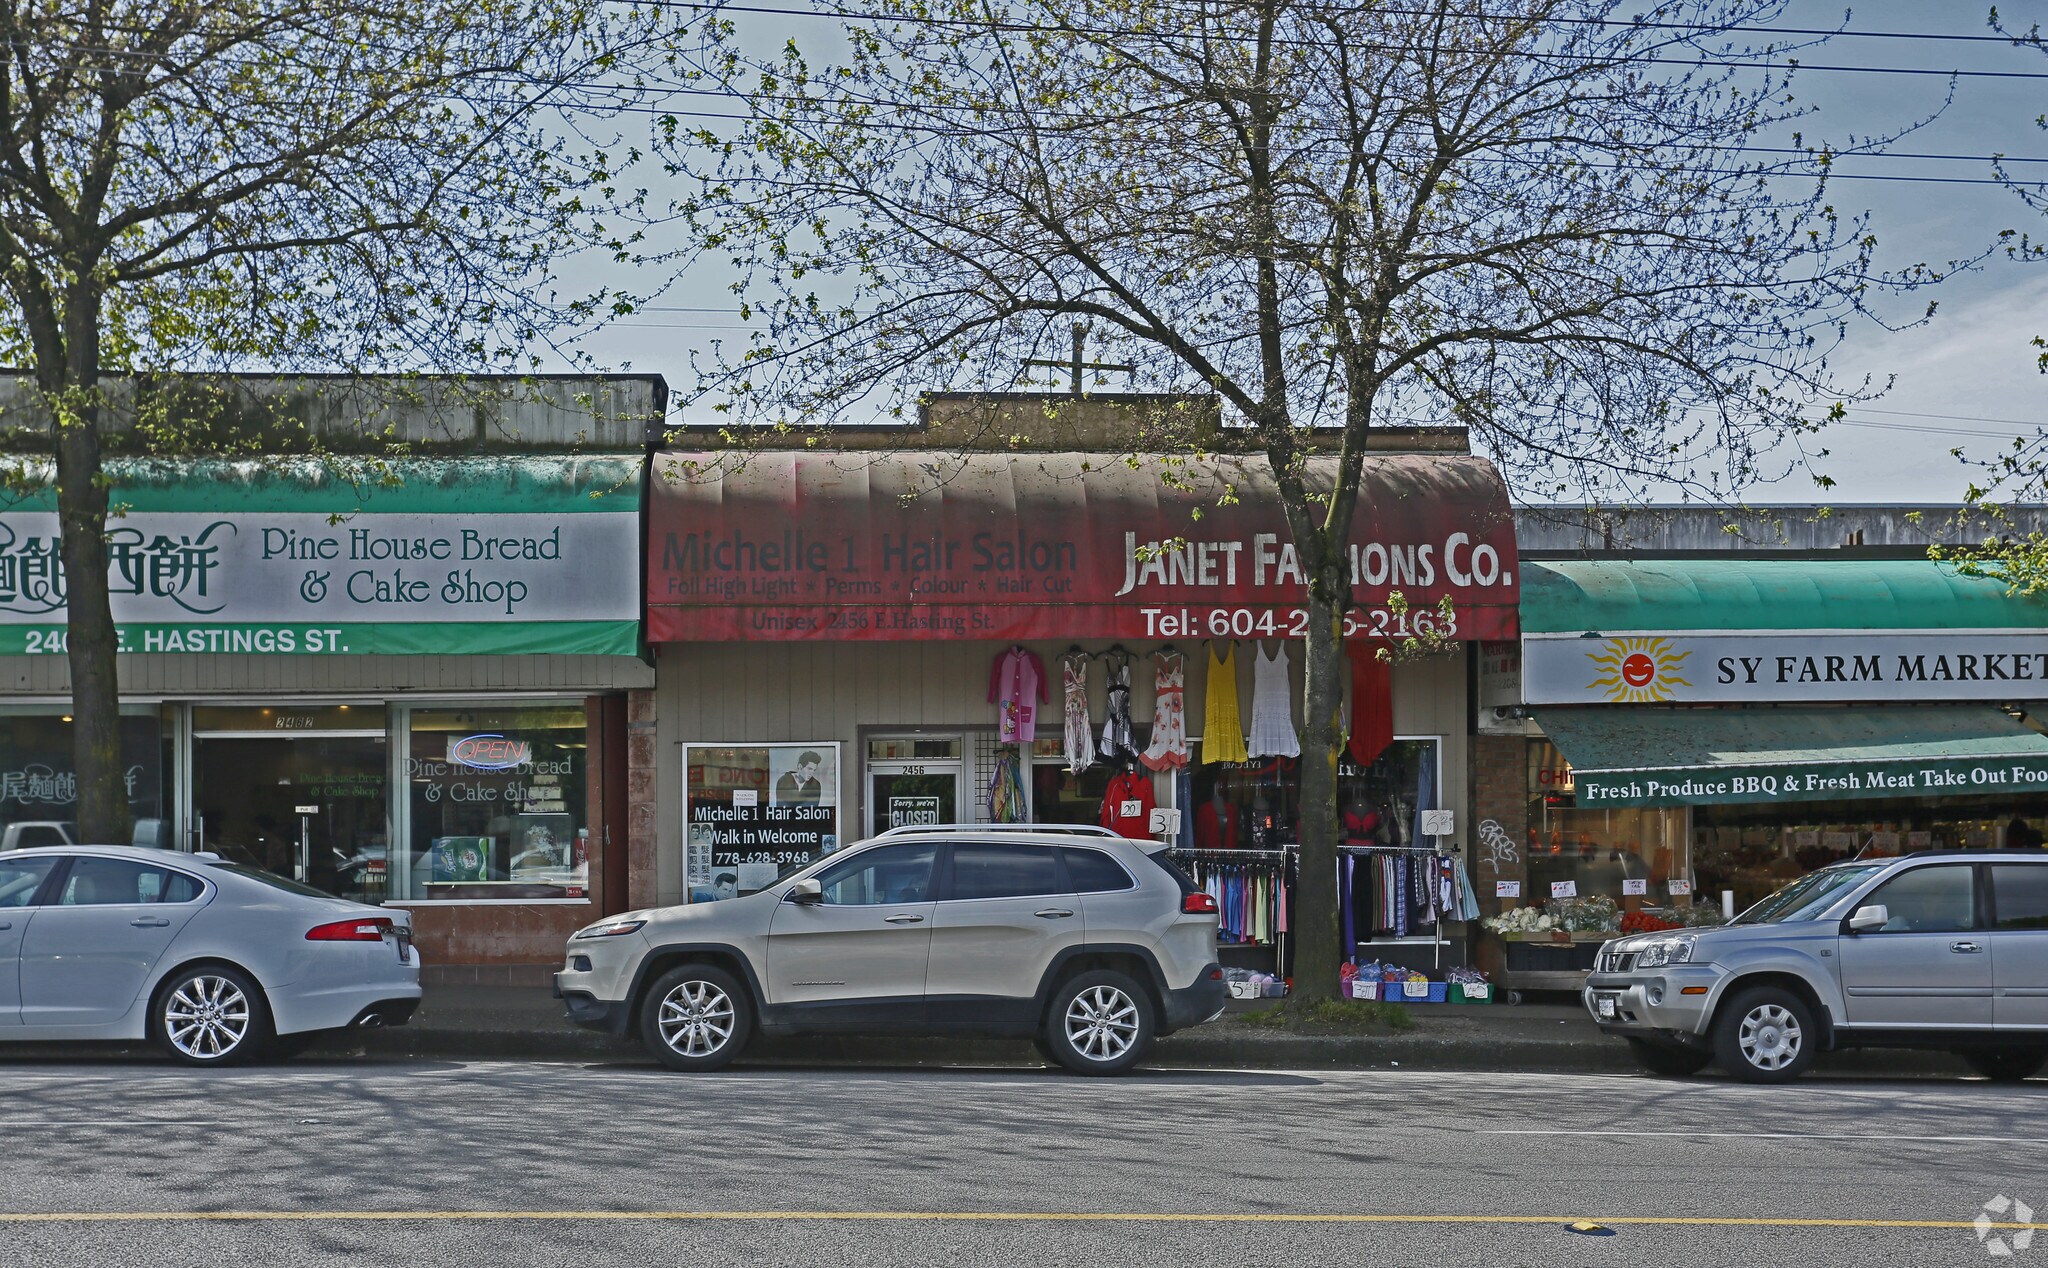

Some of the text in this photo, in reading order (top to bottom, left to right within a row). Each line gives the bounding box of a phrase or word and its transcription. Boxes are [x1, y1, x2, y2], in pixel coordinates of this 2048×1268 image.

[261, 526, 562, 560] Pine House Bread
[662, 529, 1077, 574] Michelle 1 Hair Salon
[1114, 531, 1243, 597] JANET
[1254, 533, 1435, 587] FAIONS
[300, 568, 528, 615] & Cake Shop
[706, 575, 746, 600] High
[752, 576, 797, 600] Light
[826, 576, 881, 594] Perms
[910, 575, 968, 594] Colour
[996, 576, 1032, 593] Hair
[1043, 575, 1072, 593] Cut
[752, 612, 818, 630] Unisex
[827, 612, 868, 630] 2456
[971, 612, 995, 630] St.
[1140, 608, 1458, 637] Tel: 604-25-2163
[145, 629, 296, 653] HASTINGS
[305, 628, 349, 652] ST.
[1717, 653, 2048, 685] SY FARM MARKET
[457, 740, 526, 759] OPEN
[402, 758, 447, 776] Pine
[902, 766, 925, 775] 2456
[425, 783, 442, 802] &
[450, 781, 497, 802] Cake
[1586, 782, 1642, 800] Fresh
[1647, 779, 1727, 797] Produce
[1731, 775, 1778, 796] BBQ
[1783, 775, 1800, 792] &
[1805, 773, 1860, 791] Fresh
[1866, 771, 1915, 788] Meat
[1920, 768, 1966, 787] Take
[1971, 767, 2007, 784] Out
[695, 805, 830, 821] Michelle 1 Hair Salon
[892, 810, 936, 827] CLOSED
[710, 828, 817, 845] Walk in Welcome
[716, 851, 810, 864] 778-628-3968
